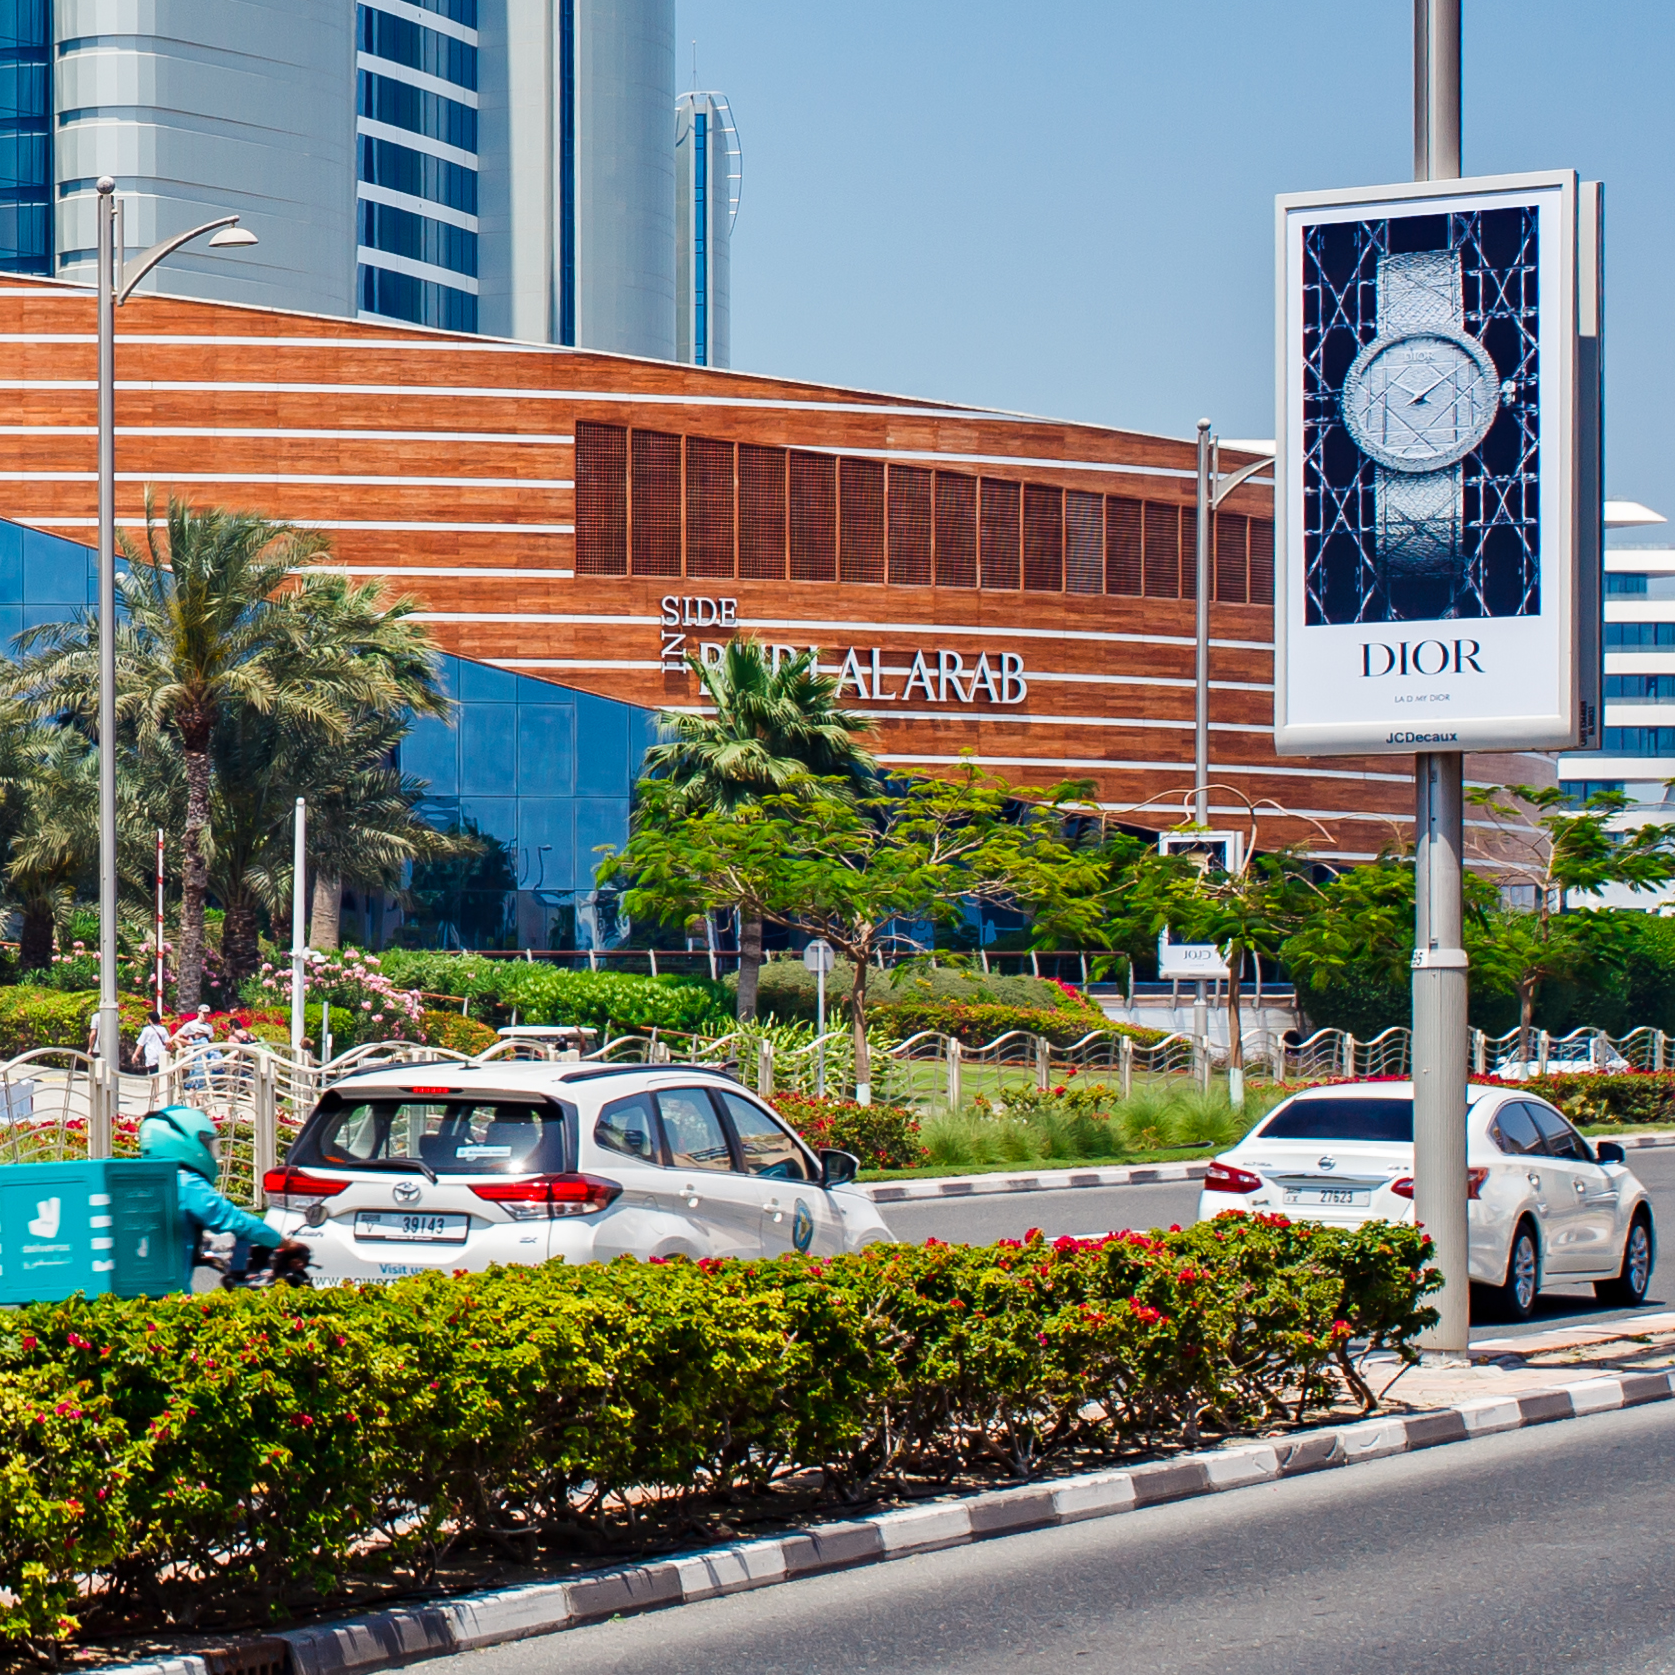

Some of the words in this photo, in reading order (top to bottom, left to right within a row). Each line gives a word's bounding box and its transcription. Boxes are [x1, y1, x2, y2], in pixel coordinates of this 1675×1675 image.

[661, 596, 738, 627] SIDE
[1358, 638, 1486, 678] DIOR
[834, 646, 896, 700] AL
[902, 648, 1028, 704] ARAB
[1386, 731, 1458, 744] JCDecaux
[1320, 1190, 1353, 1203] 27623
[402, 1216, 445, 1234] 39143
[379, 1263, 407, 1275] Visit
